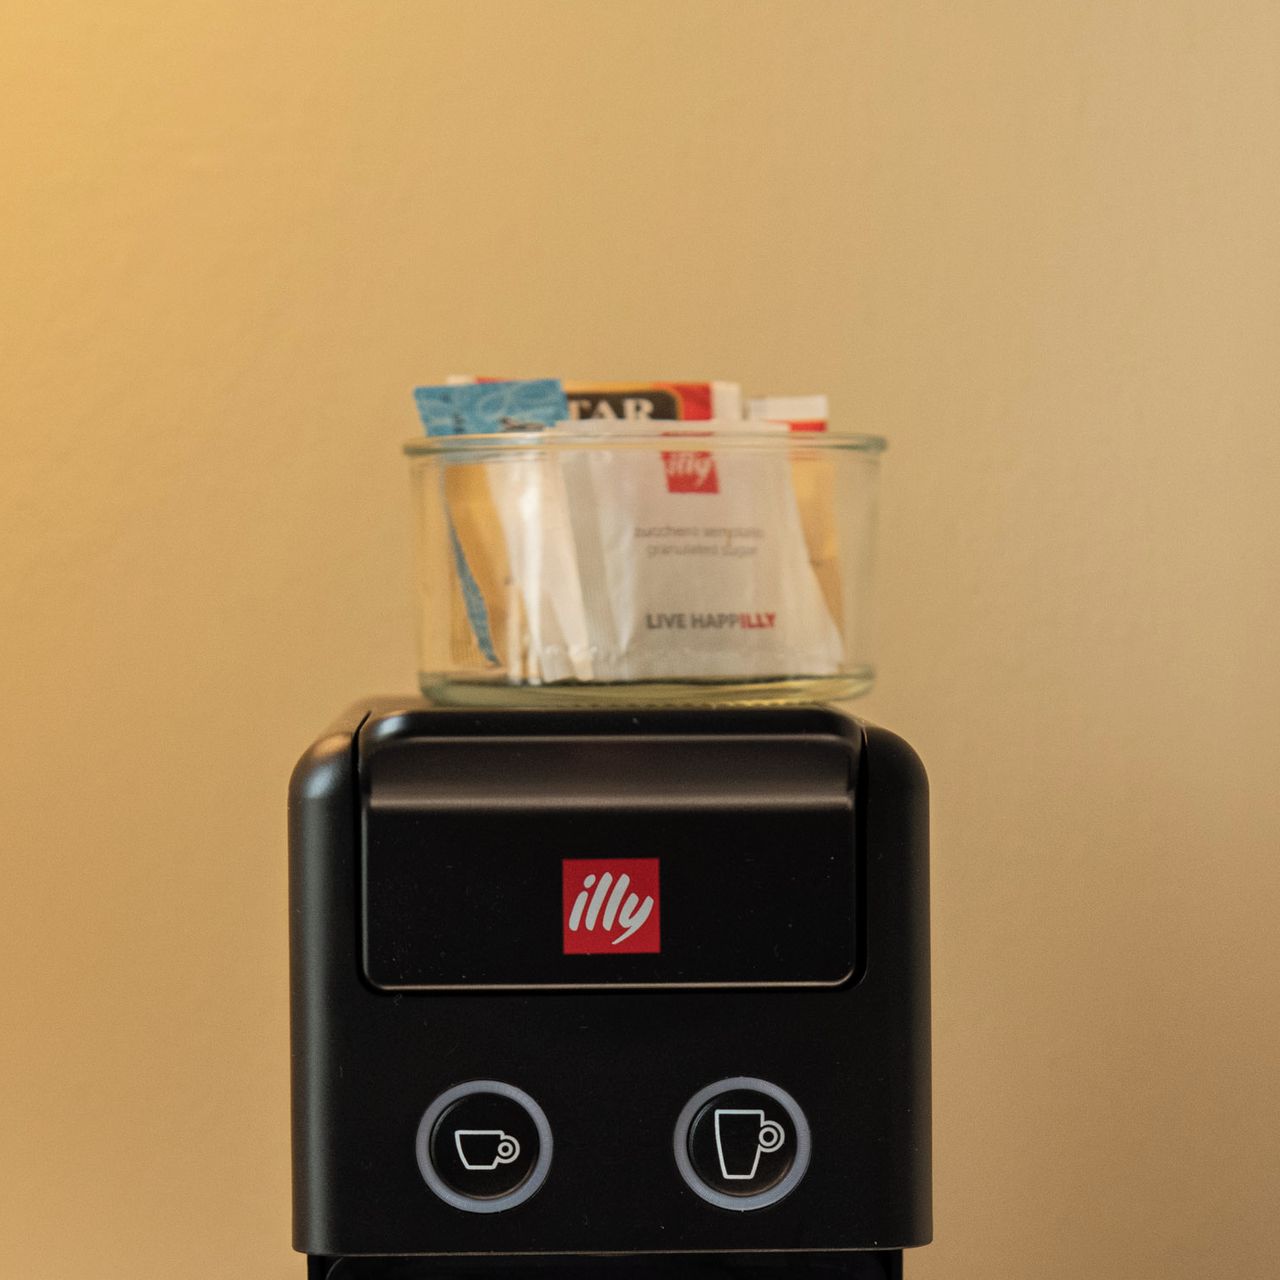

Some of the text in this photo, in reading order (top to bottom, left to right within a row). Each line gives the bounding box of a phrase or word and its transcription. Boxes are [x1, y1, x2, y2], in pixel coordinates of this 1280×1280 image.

[646, 545, 719, 559] granulated
[646, 612, 776, 630] LIVE HAPPILLY
[568, 871, 655, 945] illy
